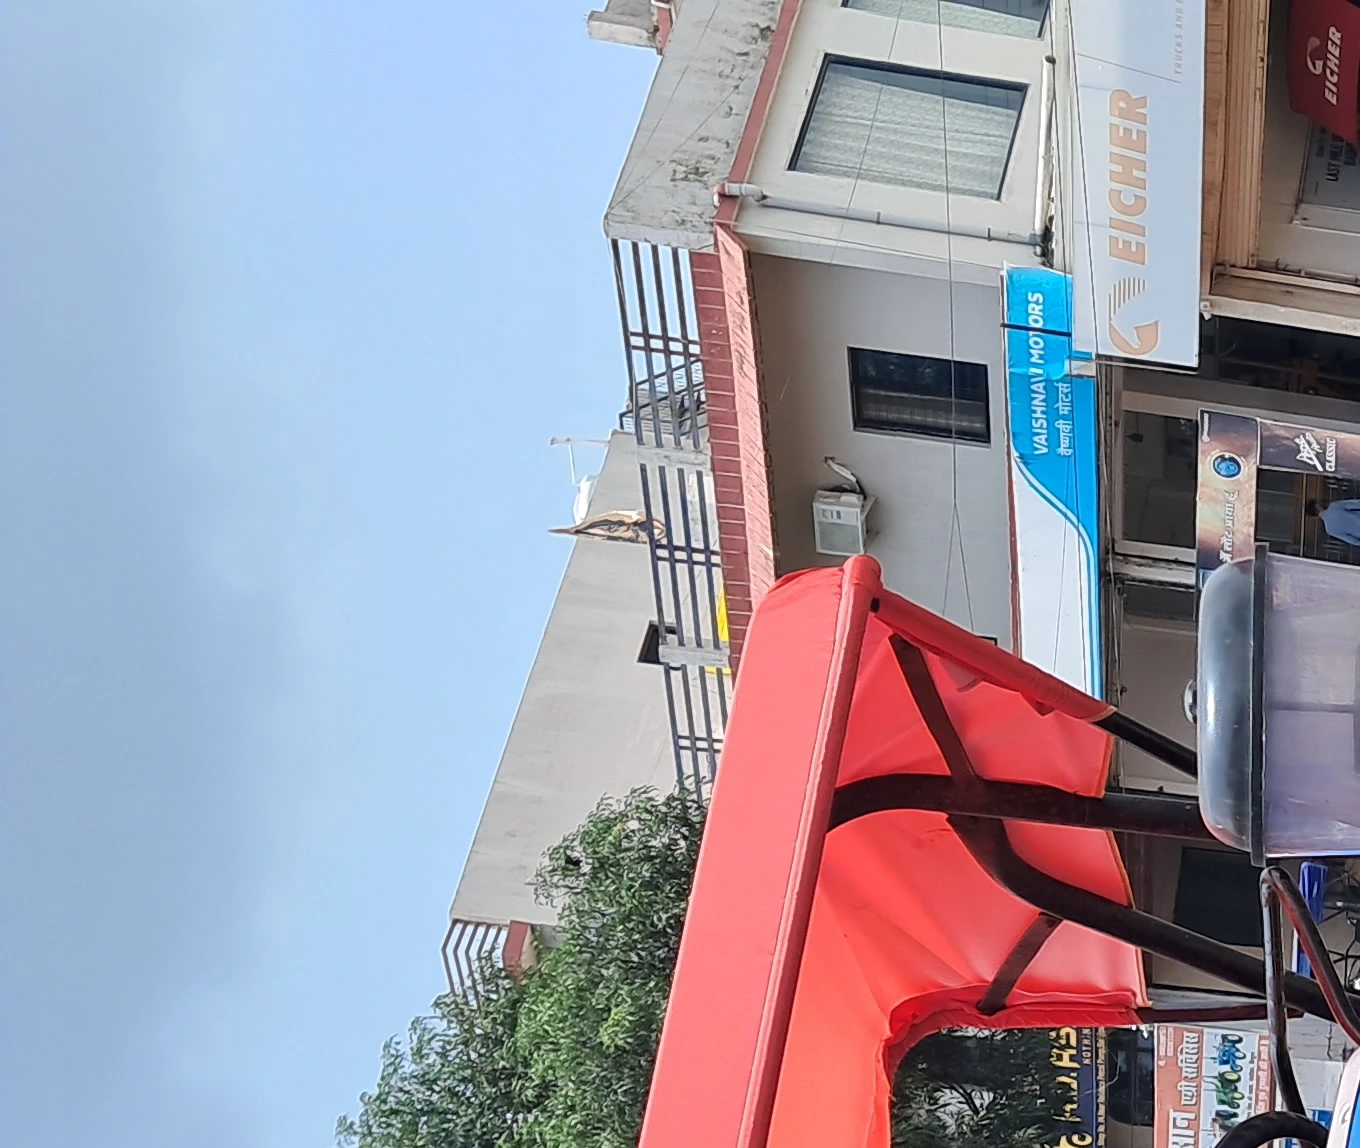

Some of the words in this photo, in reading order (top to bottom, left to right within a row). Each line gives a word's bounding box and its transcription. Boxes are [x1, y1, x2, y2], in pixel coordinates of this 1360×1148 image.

[1173, 33, 1184, 75] TRUCKS
[1323, 25, 1343, 106] EICHER
[1108, 88, 1148, 266] EICHER
[1027, 367, 1048, 455] VAISHNAVI
[1053, 382, 1072, 415] मोटर्स
